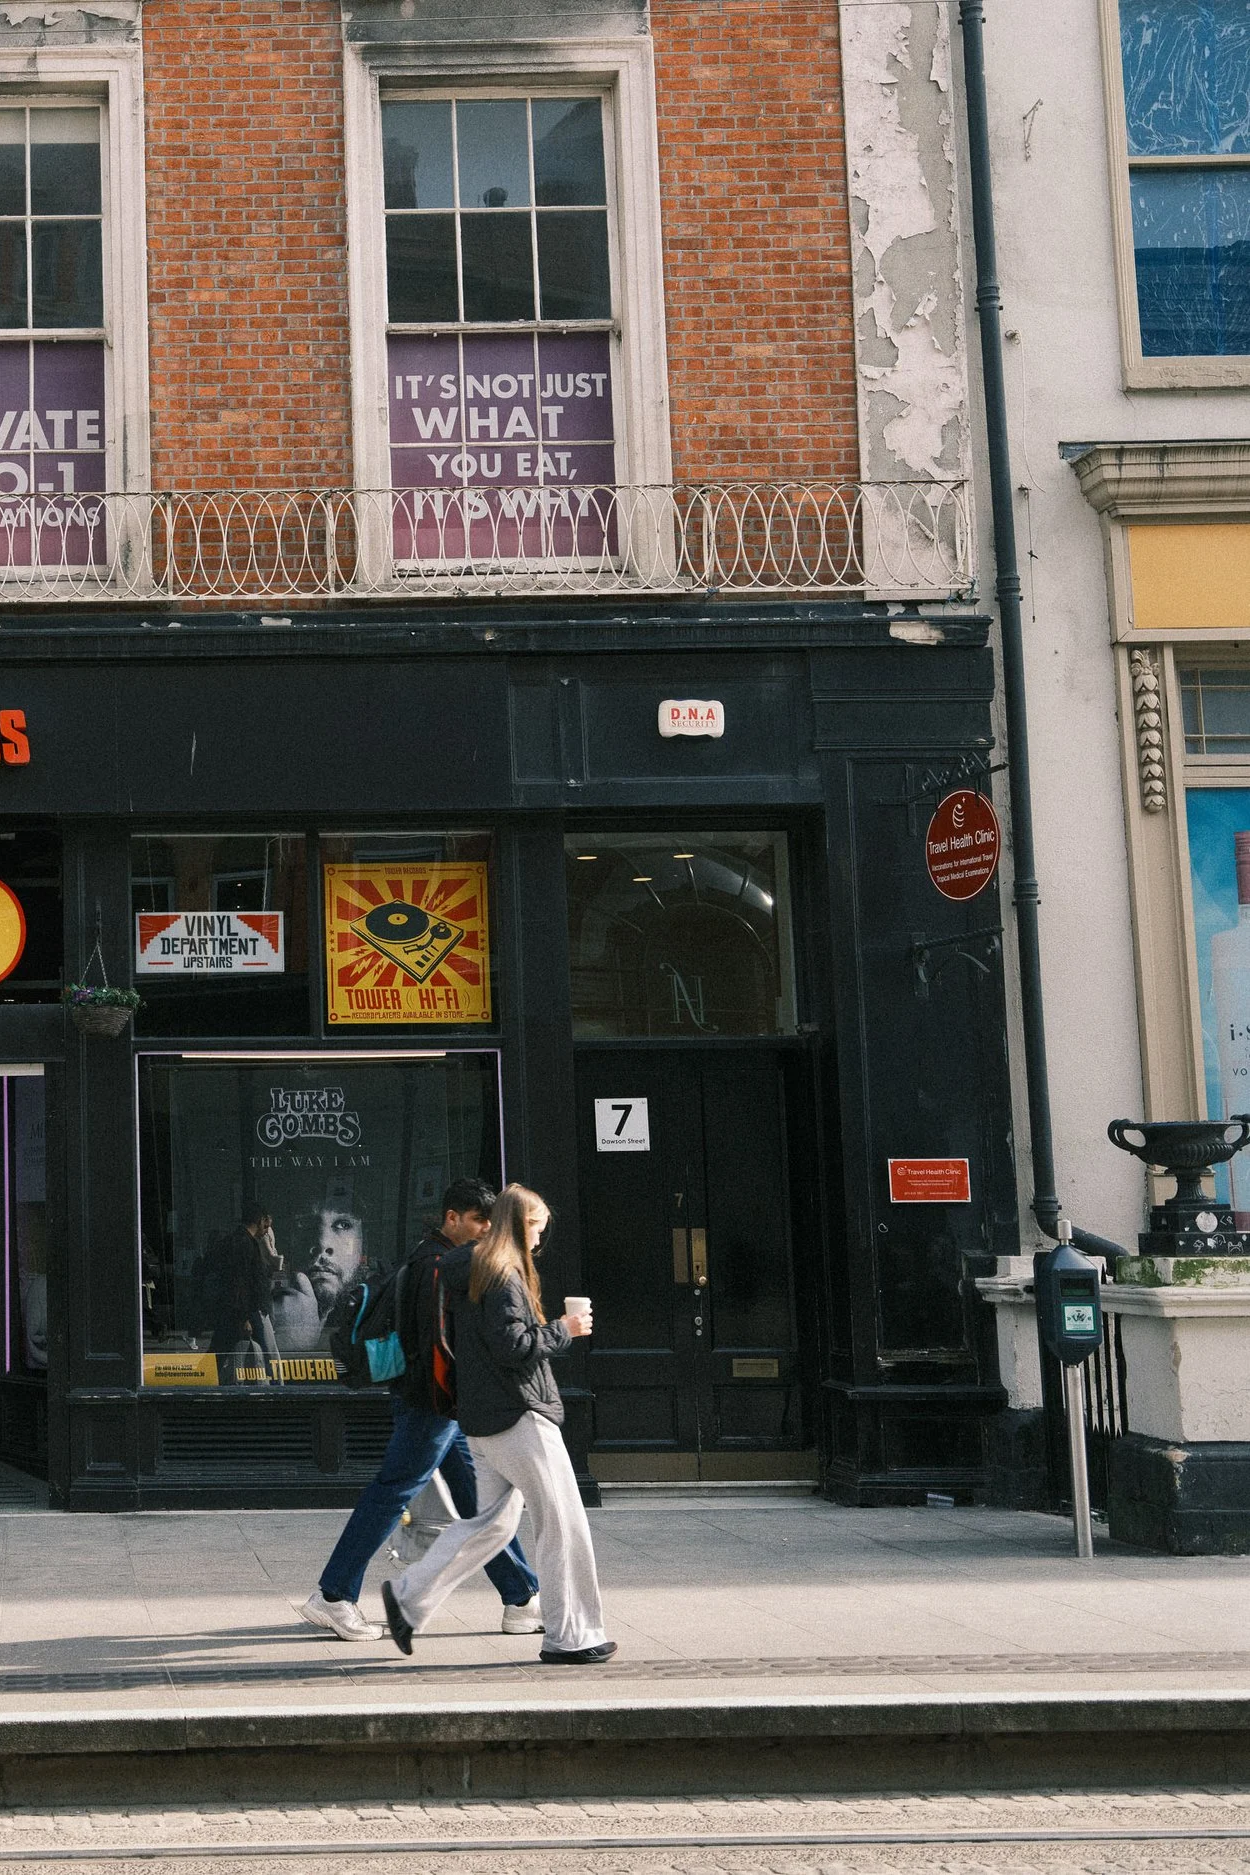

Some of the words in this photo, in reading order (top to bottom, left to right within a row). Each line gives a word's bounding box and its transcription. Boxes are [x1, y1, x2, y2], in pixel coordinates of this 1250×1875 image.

[395, 374, 457, 399] IT'S
[466, 373, 535, 399] NOT
[541, 372, 607, 398] JUST
[411, 405, 564, 439] WHAT
[427, 453, 502, 479] YOU
[517, 452, 578, 480] EAT,
[499, 488, 593, 518] WHY
[671, 708, 715, 720] D.N.A
[671, 720, 715, 728] SECURITY
[929, 837, 949, 855] Travel
[950, 832, 973, 851] Health
[975, 828, 995, 845] Clinic
[982, 852, 994, 861] Travel
[184, 915, 238, 936] VINYL
[160, 937, 259, 956] DEPARTMENT
[183, 956, 233, 969] UPSTAIRS
[344, 988, 402, 1010] TOWER
[417, 988, 460, 1010] HI-FI
[270, 1087, 346, 1113] LUKE
[256, 1111, 362, 1148] COMBS
[611, 1104, 632, 1137] 7
[250, 1156, 283, 1168] THE
[291, 1156, 324, 1167] WAY
[349, 1155, 371, 1167] AM
